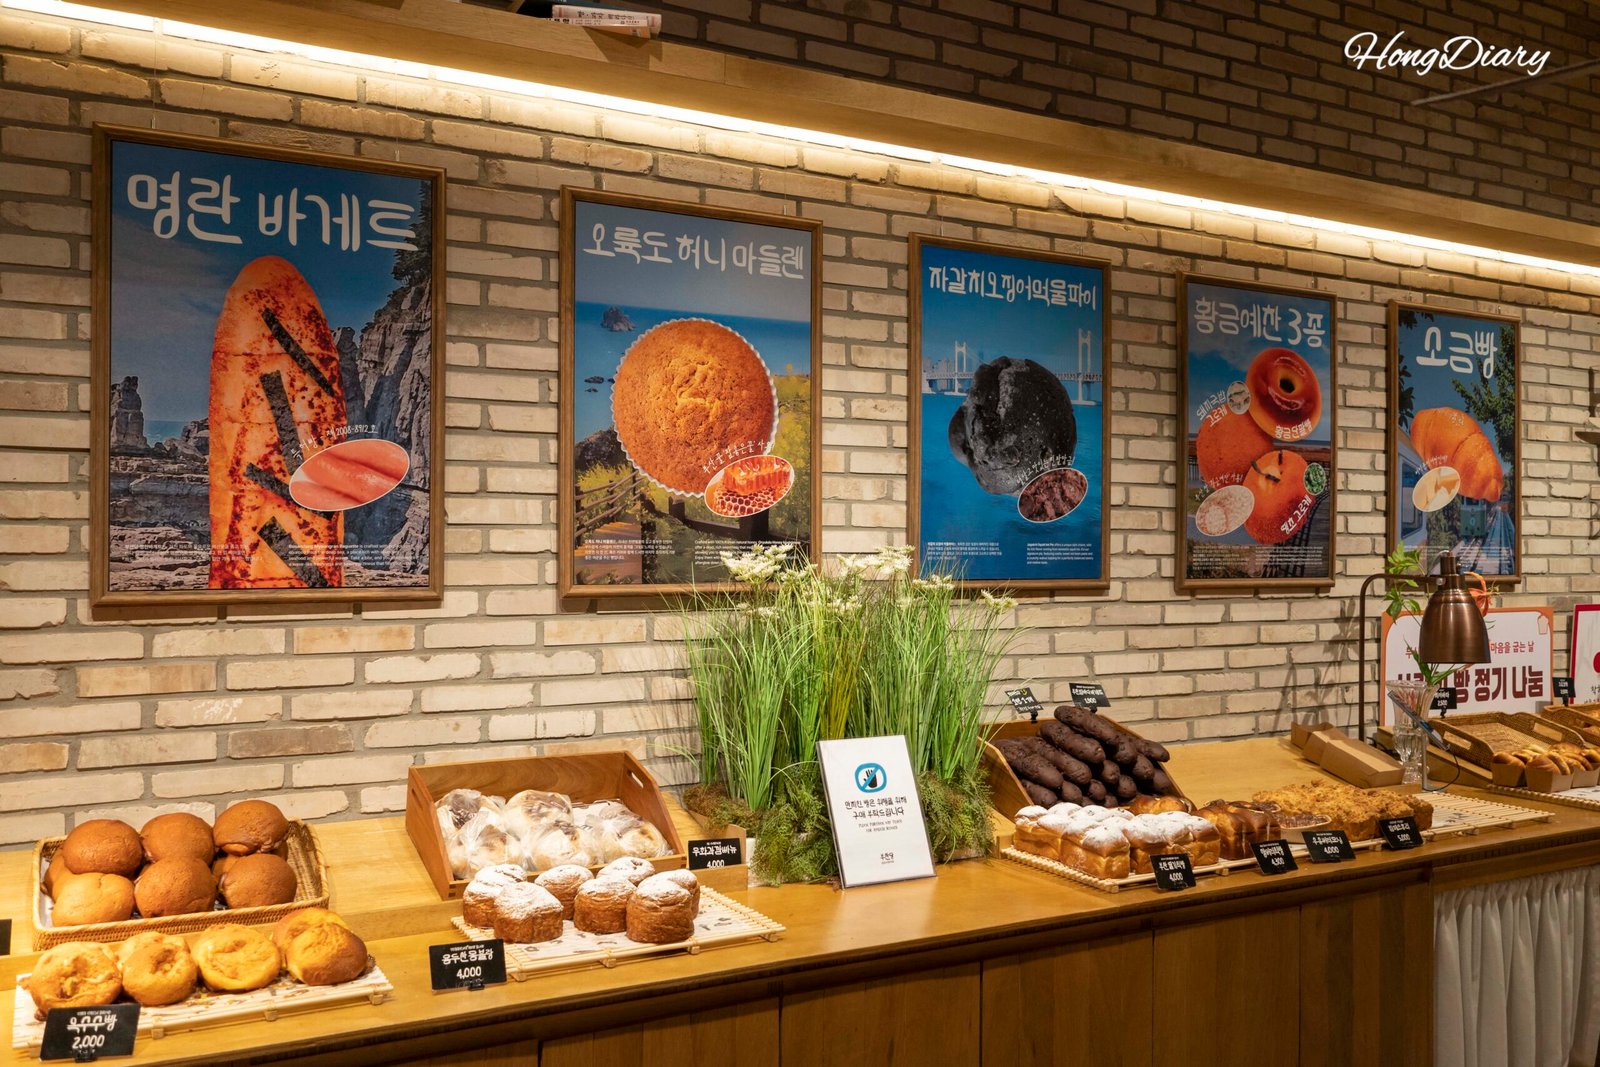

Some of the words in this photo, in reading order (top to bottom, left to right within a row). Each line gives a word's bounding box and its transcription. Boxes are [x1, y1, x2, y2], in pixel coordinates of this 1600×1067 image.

[127, 171, 243, 245] 명란
[259, 187, 419, 252] 바게트
[583, 223, 673, 265] 오륙도
[675, 234, 726, 272] 허니
[732, 241, 804, 279] 마들렌
[1194, 296, 1282, 342] 황금예찬
[1287, 308, 1326, 348] 3종
[1416, 326, 1498, 379] 소금빵
[1453, 667, 1470, 704] 빵
[1474, 666, 1507, 702] 정기
[1512, 665, 1544, 699] 나눔
[707, 859, 725, 869] 4,000
[456, 966, 482, 979] 4,000
[67, 1014, 118, 1034] 옥수수빵
[72, 1034, 105, 1049] 2,000
